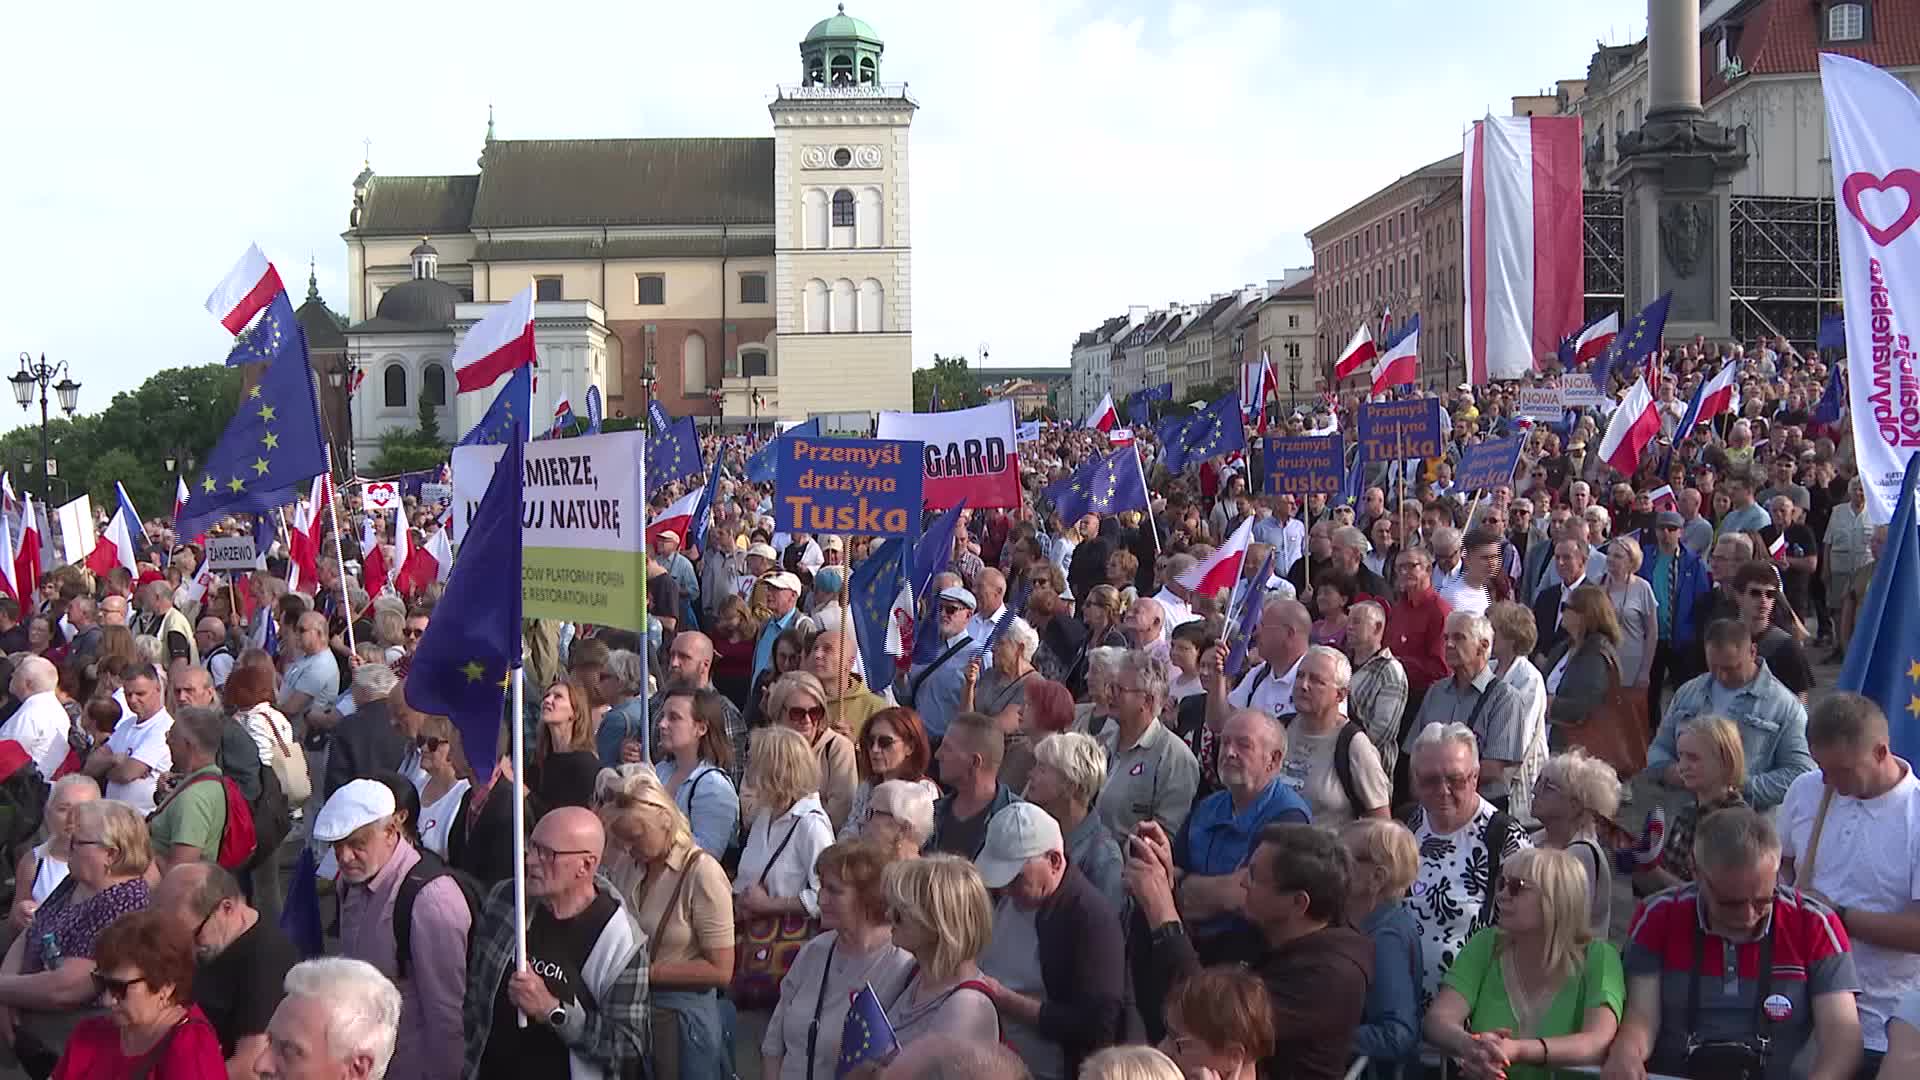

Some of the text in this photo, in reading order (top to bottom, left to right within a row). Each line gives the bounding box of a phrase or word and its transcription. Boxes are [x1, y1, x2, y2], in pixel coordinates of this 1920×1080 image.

[1523, 391, 1560, 405] NOWA
[794, 440, 902, 469] Przemyśl
[494, 455, 599, 491] MIERZE,
[798, 468, 896, 497] drużyna
[1271, 472, 1339, 493] Tuska
[551, 499, 621, 538] NATURĘ
[785, 496, 908, 532] Tuska
